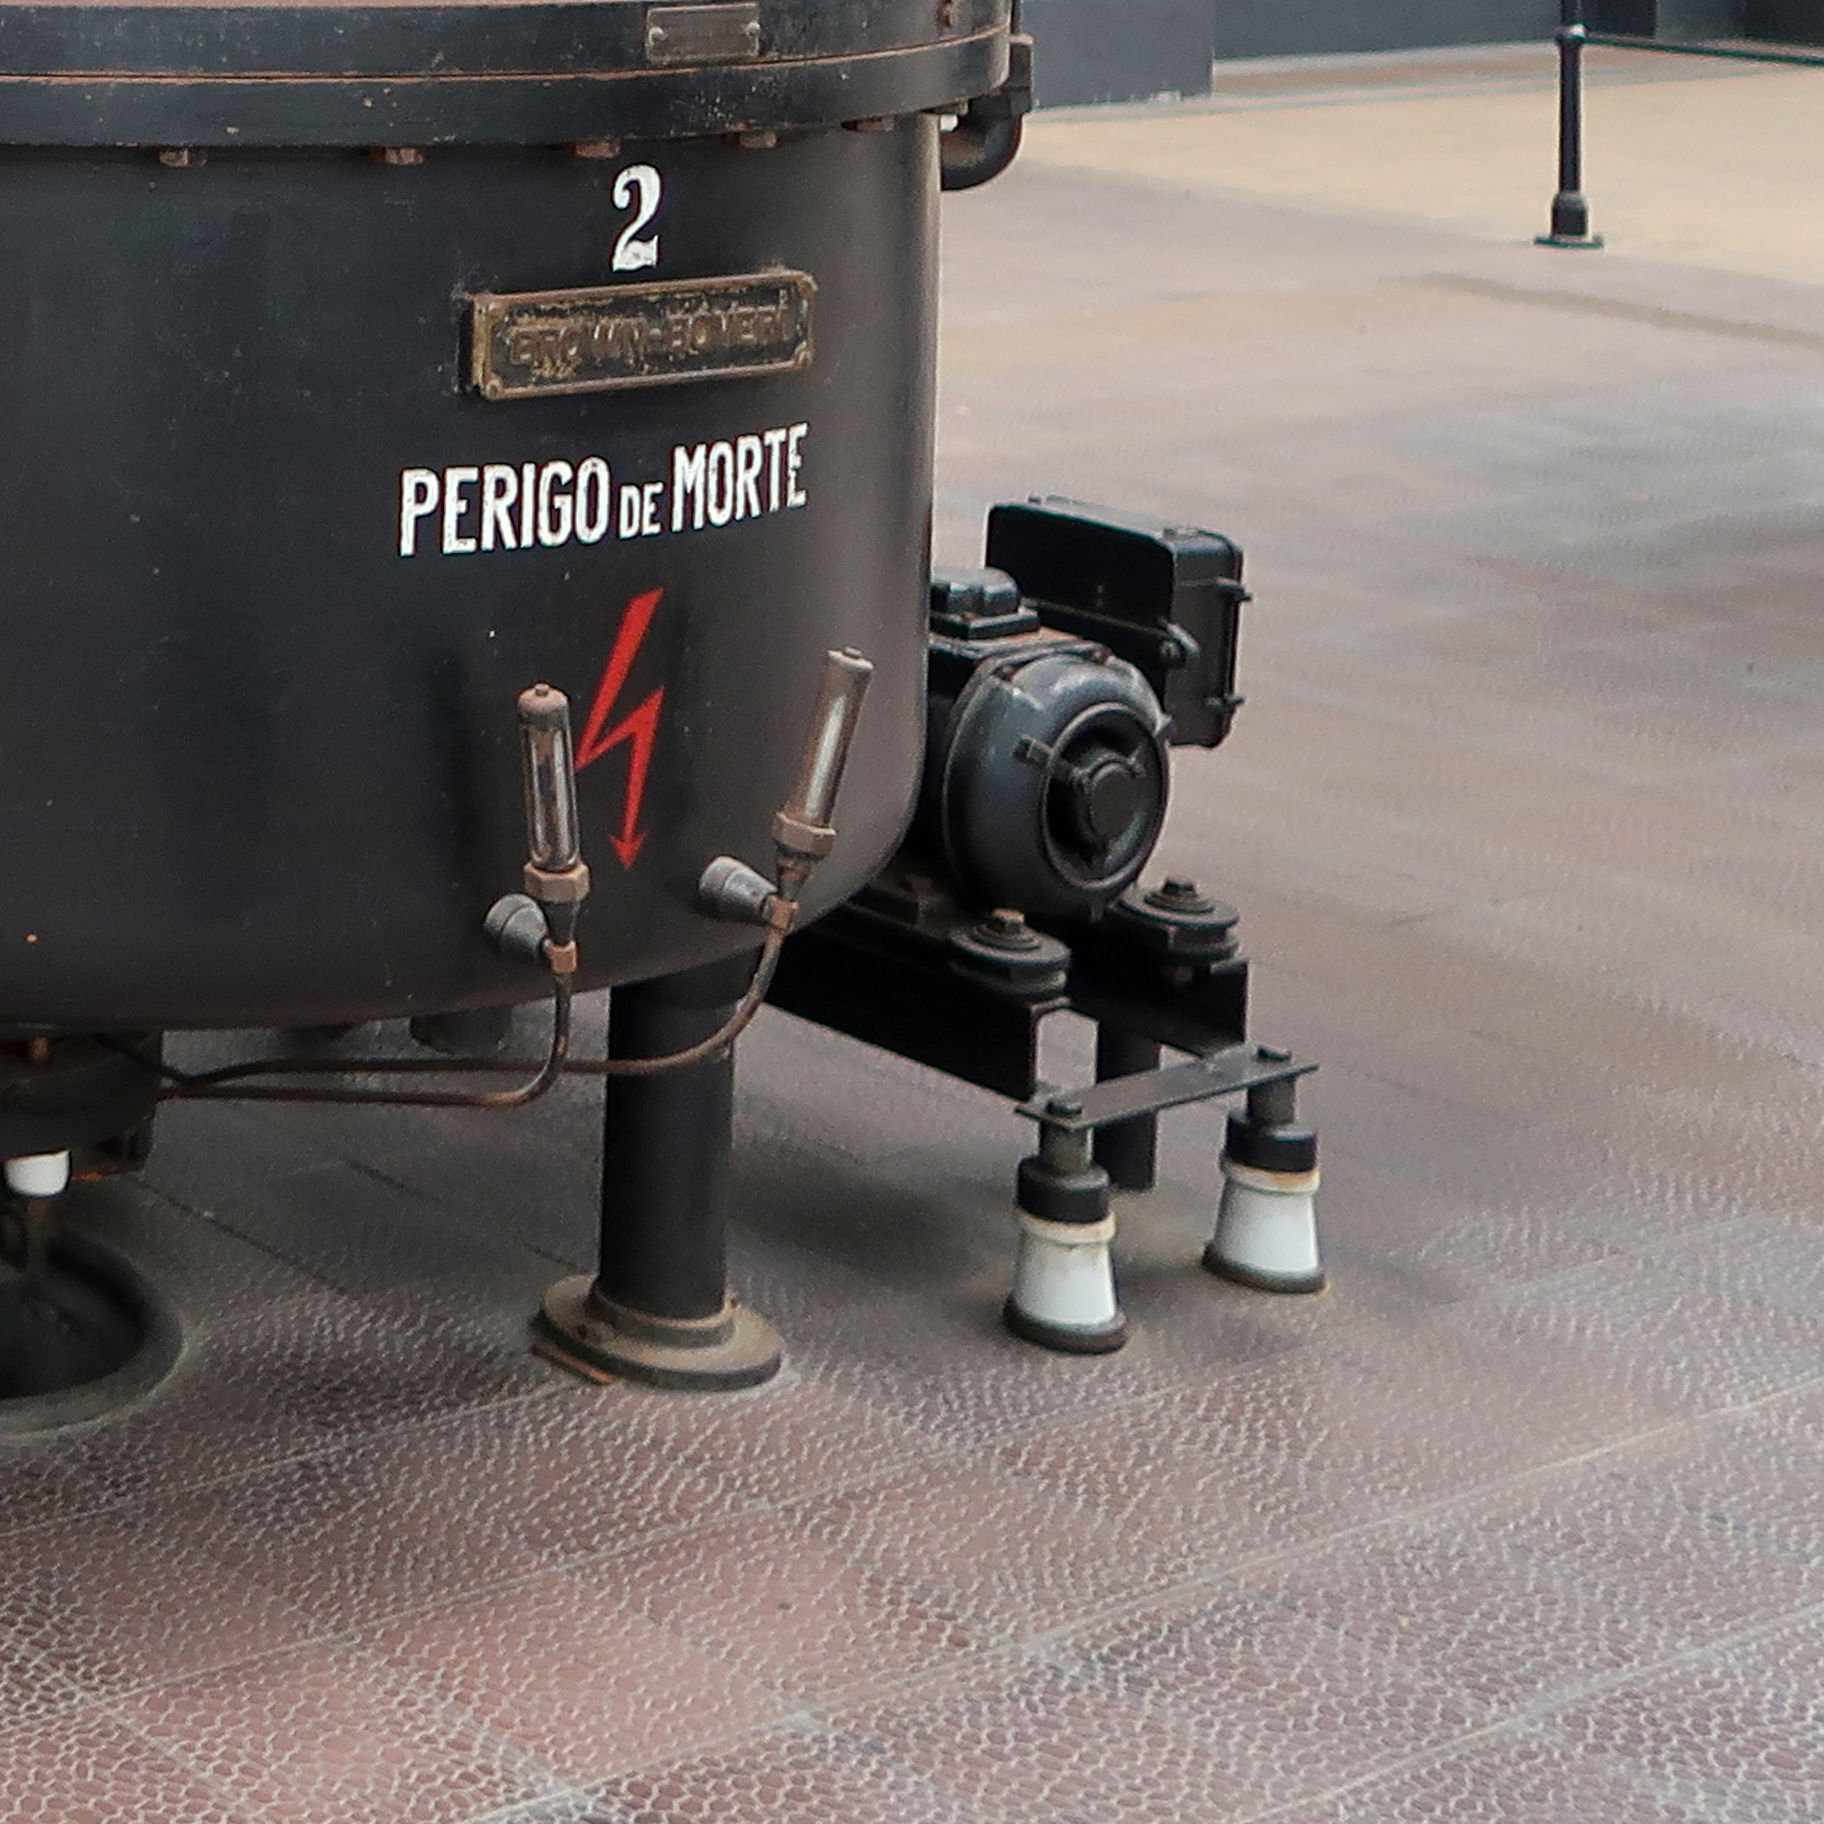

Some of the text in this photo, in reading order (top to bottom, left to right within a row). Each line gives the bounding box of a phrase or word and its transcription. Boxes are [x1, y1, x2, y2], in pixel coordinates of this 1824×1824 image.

[610, 162, 663, 272] 2
[398, 421, 810, 557] PERIGO DE MORTE
